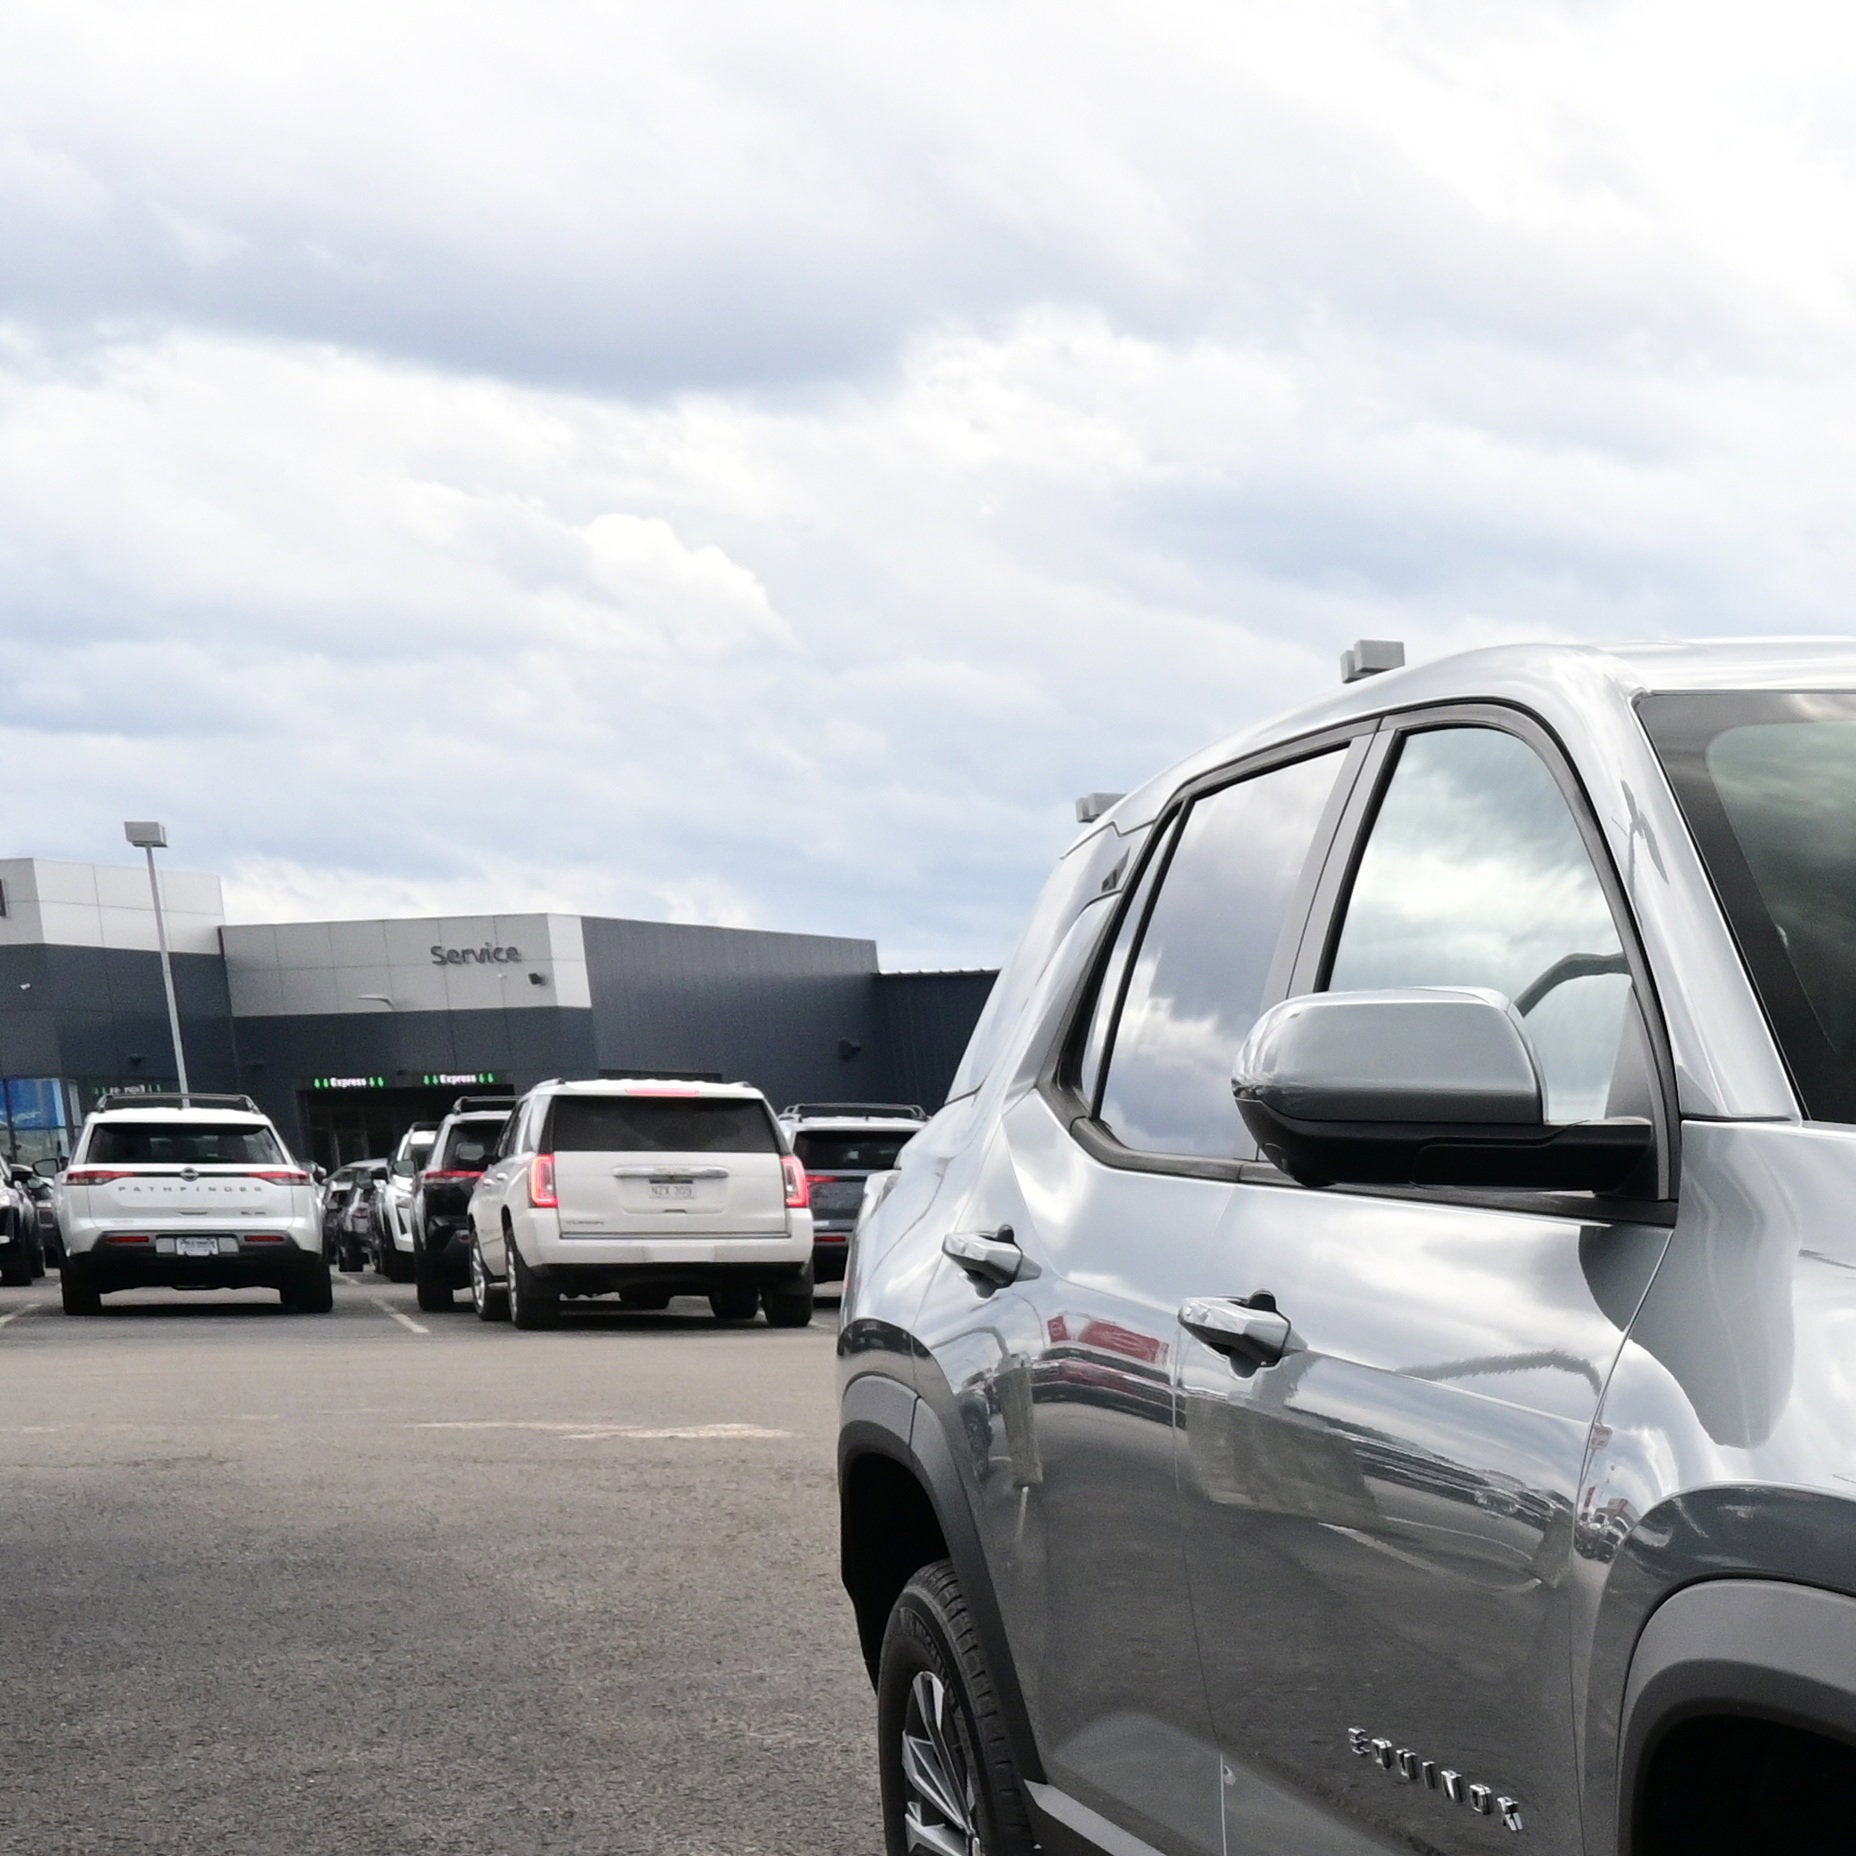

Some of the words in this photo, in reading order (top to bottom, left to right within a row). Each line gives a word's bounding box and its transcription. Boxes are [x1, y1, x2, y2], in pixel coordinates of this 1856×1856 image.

[430, 942, 521, 965] Service
[330, 1077, 367, 1088] Express
[440, 1073, 476, 1085] Express
